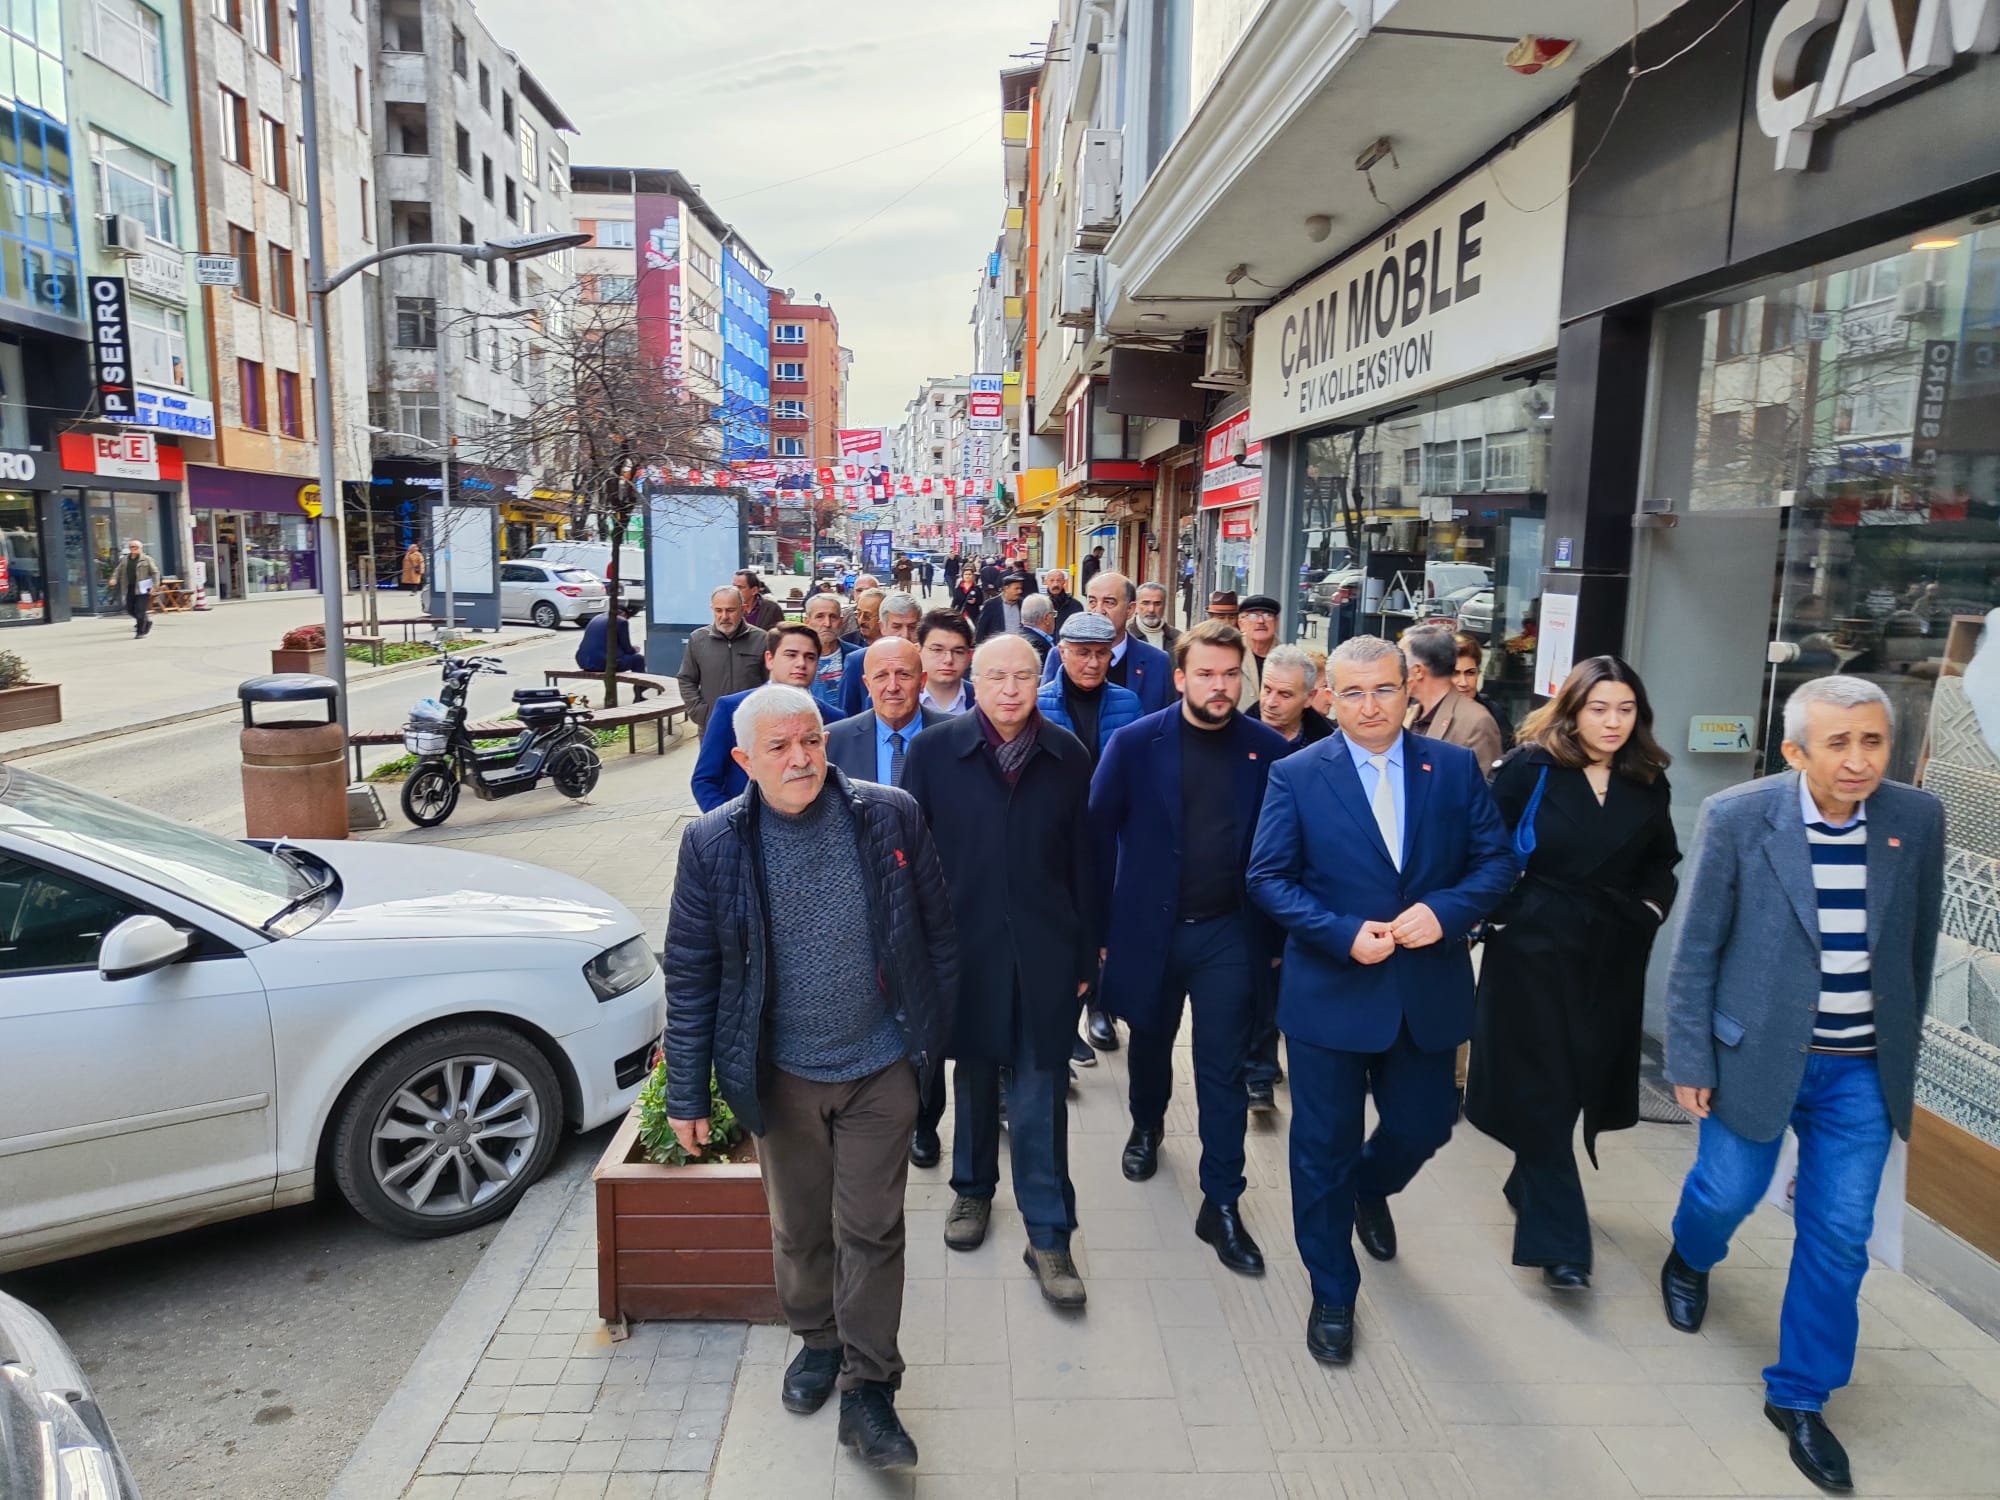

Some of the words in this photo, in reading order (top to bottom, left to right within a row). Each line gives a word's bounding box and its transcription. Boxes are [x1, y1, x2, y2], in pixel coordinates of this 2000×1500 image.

[1281, 290, 1338, 397] ÇAM
[1346, 201, 1486, 352] MÖBLE
[1300, 378, 1321, 414] EV
